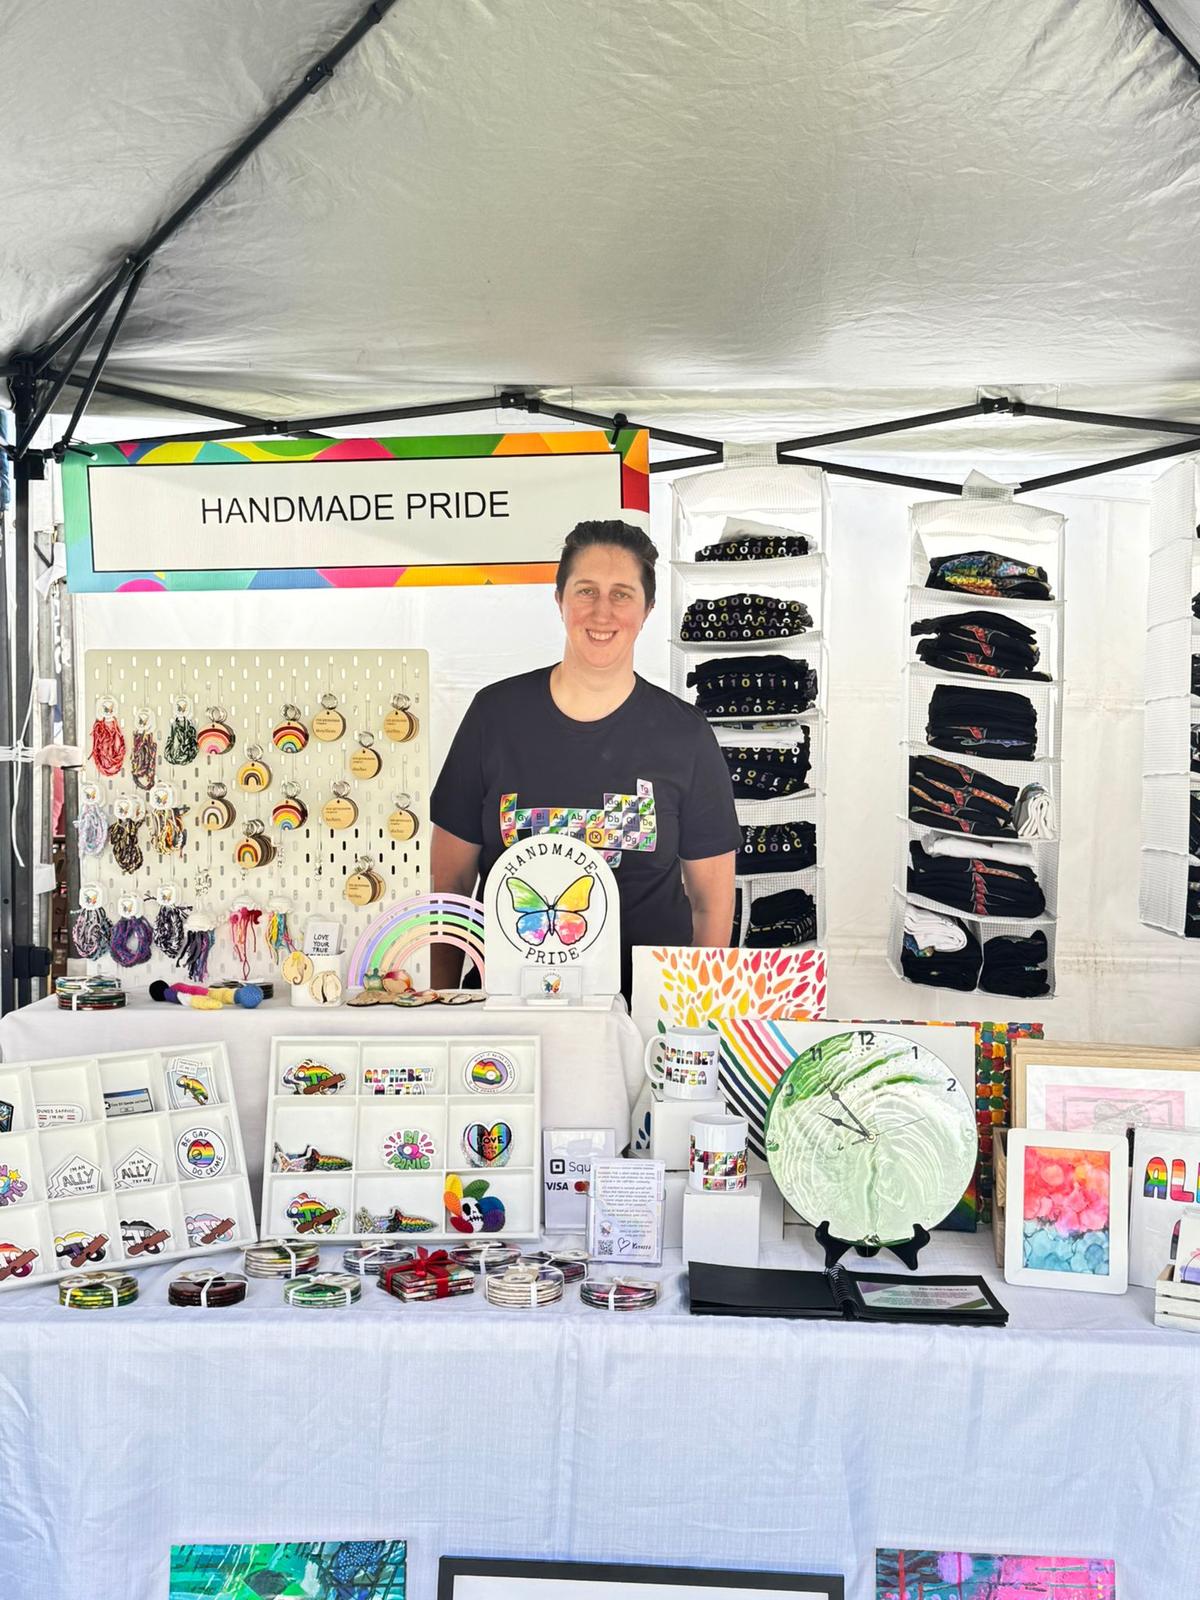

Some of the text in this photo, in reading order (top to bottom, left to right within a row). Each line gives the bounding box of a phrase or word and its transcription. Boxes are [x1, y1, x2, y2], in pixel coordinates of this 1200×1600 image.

[202, 490, 510, 524] HANDMADE PRIDE
[505, 843, 598, 876] HANDMADE
[313, 933, 330, 941] LOVE
[525, 947, 580, 965] PRIDE
[858, 1031, 875, 1046] 12
[809, 1047, 823, 1061] 11
[911, 1046, 919, 1060] 1
[665, 1066, 707, 1085] MAFIA
[946, 1078, 957, 1092] 2
[181, 1130, 210, 1148] BE GAY
[404, 1130, 419, 1145] BI
[192, 1155, 223, 1176] DO CRIME
[387, 1153, 431, 1170] PANIC
[62, 1168, 94, 1188] ALLY
[121, 1163, 152, 1180] ALLY
[1143, 1156, 1200, 1204] AL
[545, 1181, 569, 1191] VISA
